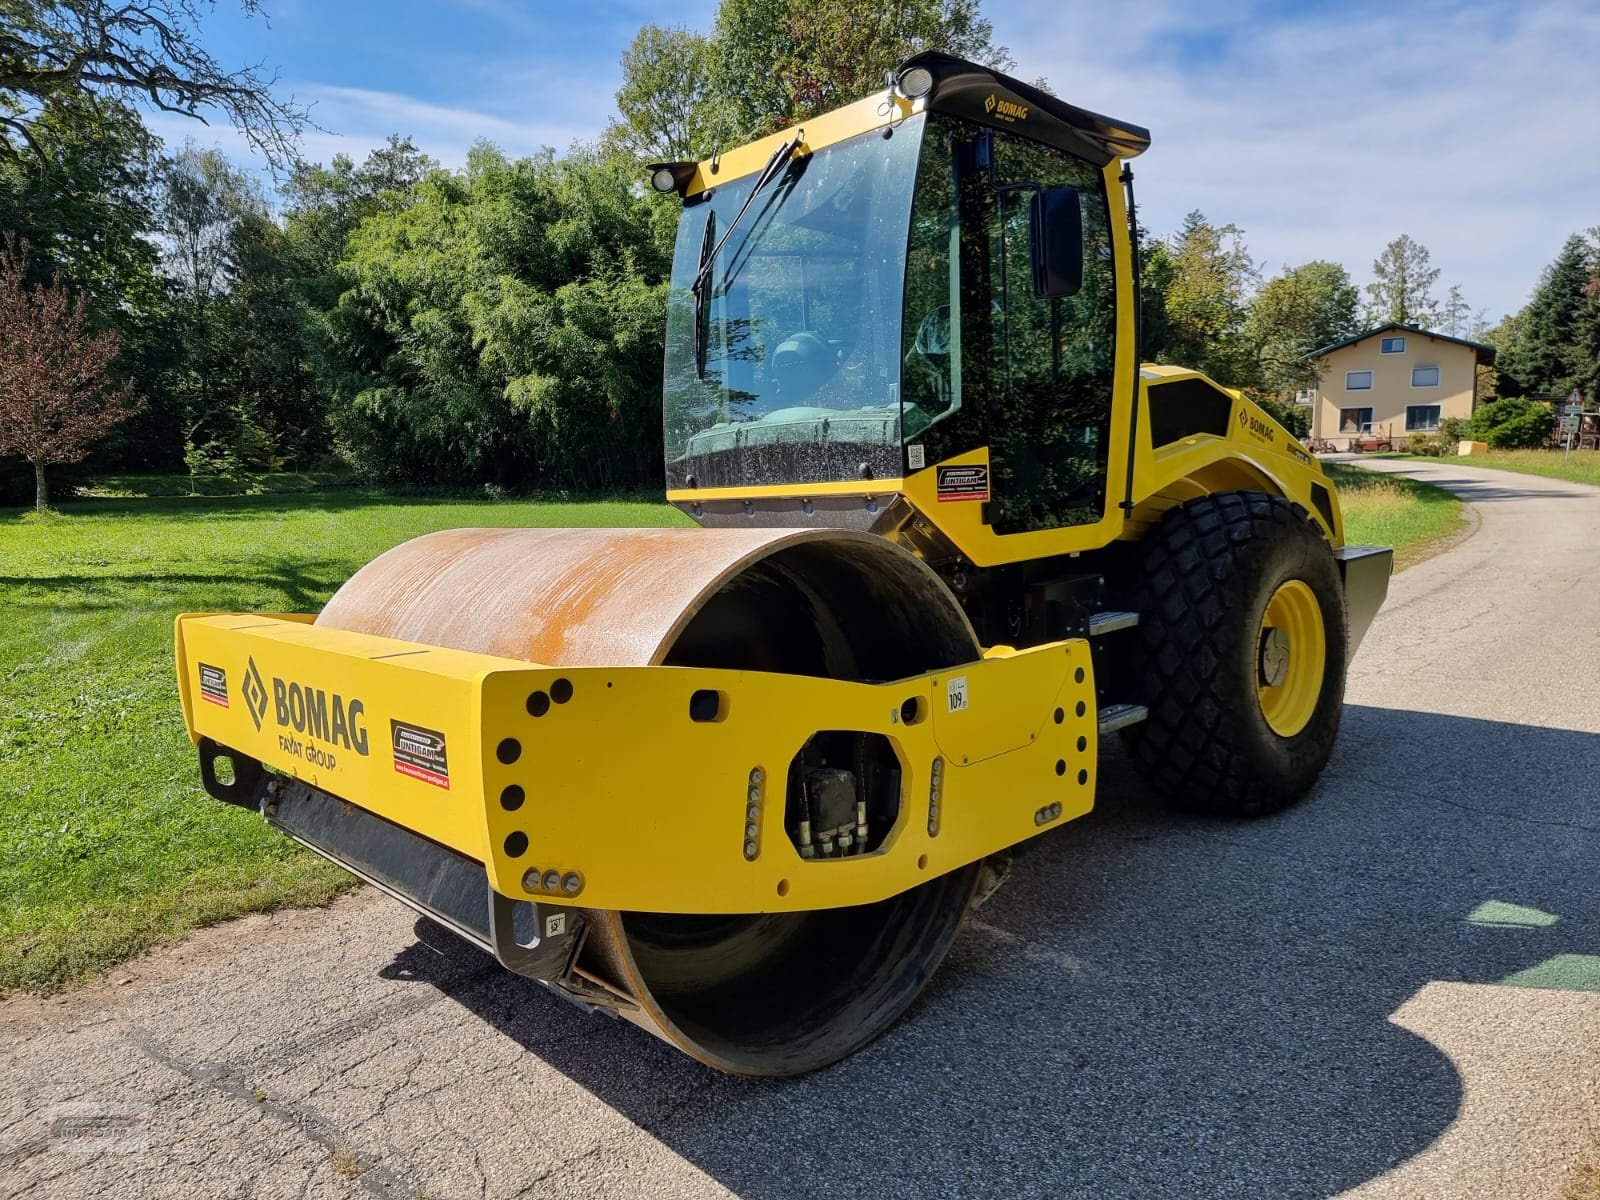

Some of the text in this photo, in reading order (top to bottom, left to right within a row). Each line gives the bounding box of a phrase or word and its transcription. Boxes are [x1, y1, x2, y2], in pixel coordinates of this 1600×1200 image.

[996, 100, 1028, 120] BOMAG
[1249, 416, 1274, 442] BOMAG
[949, 691, 962, 711] 109
[272, 677, 369, 757] BOMAG
[278, 734, 336, 771] FAYAT GROUP
